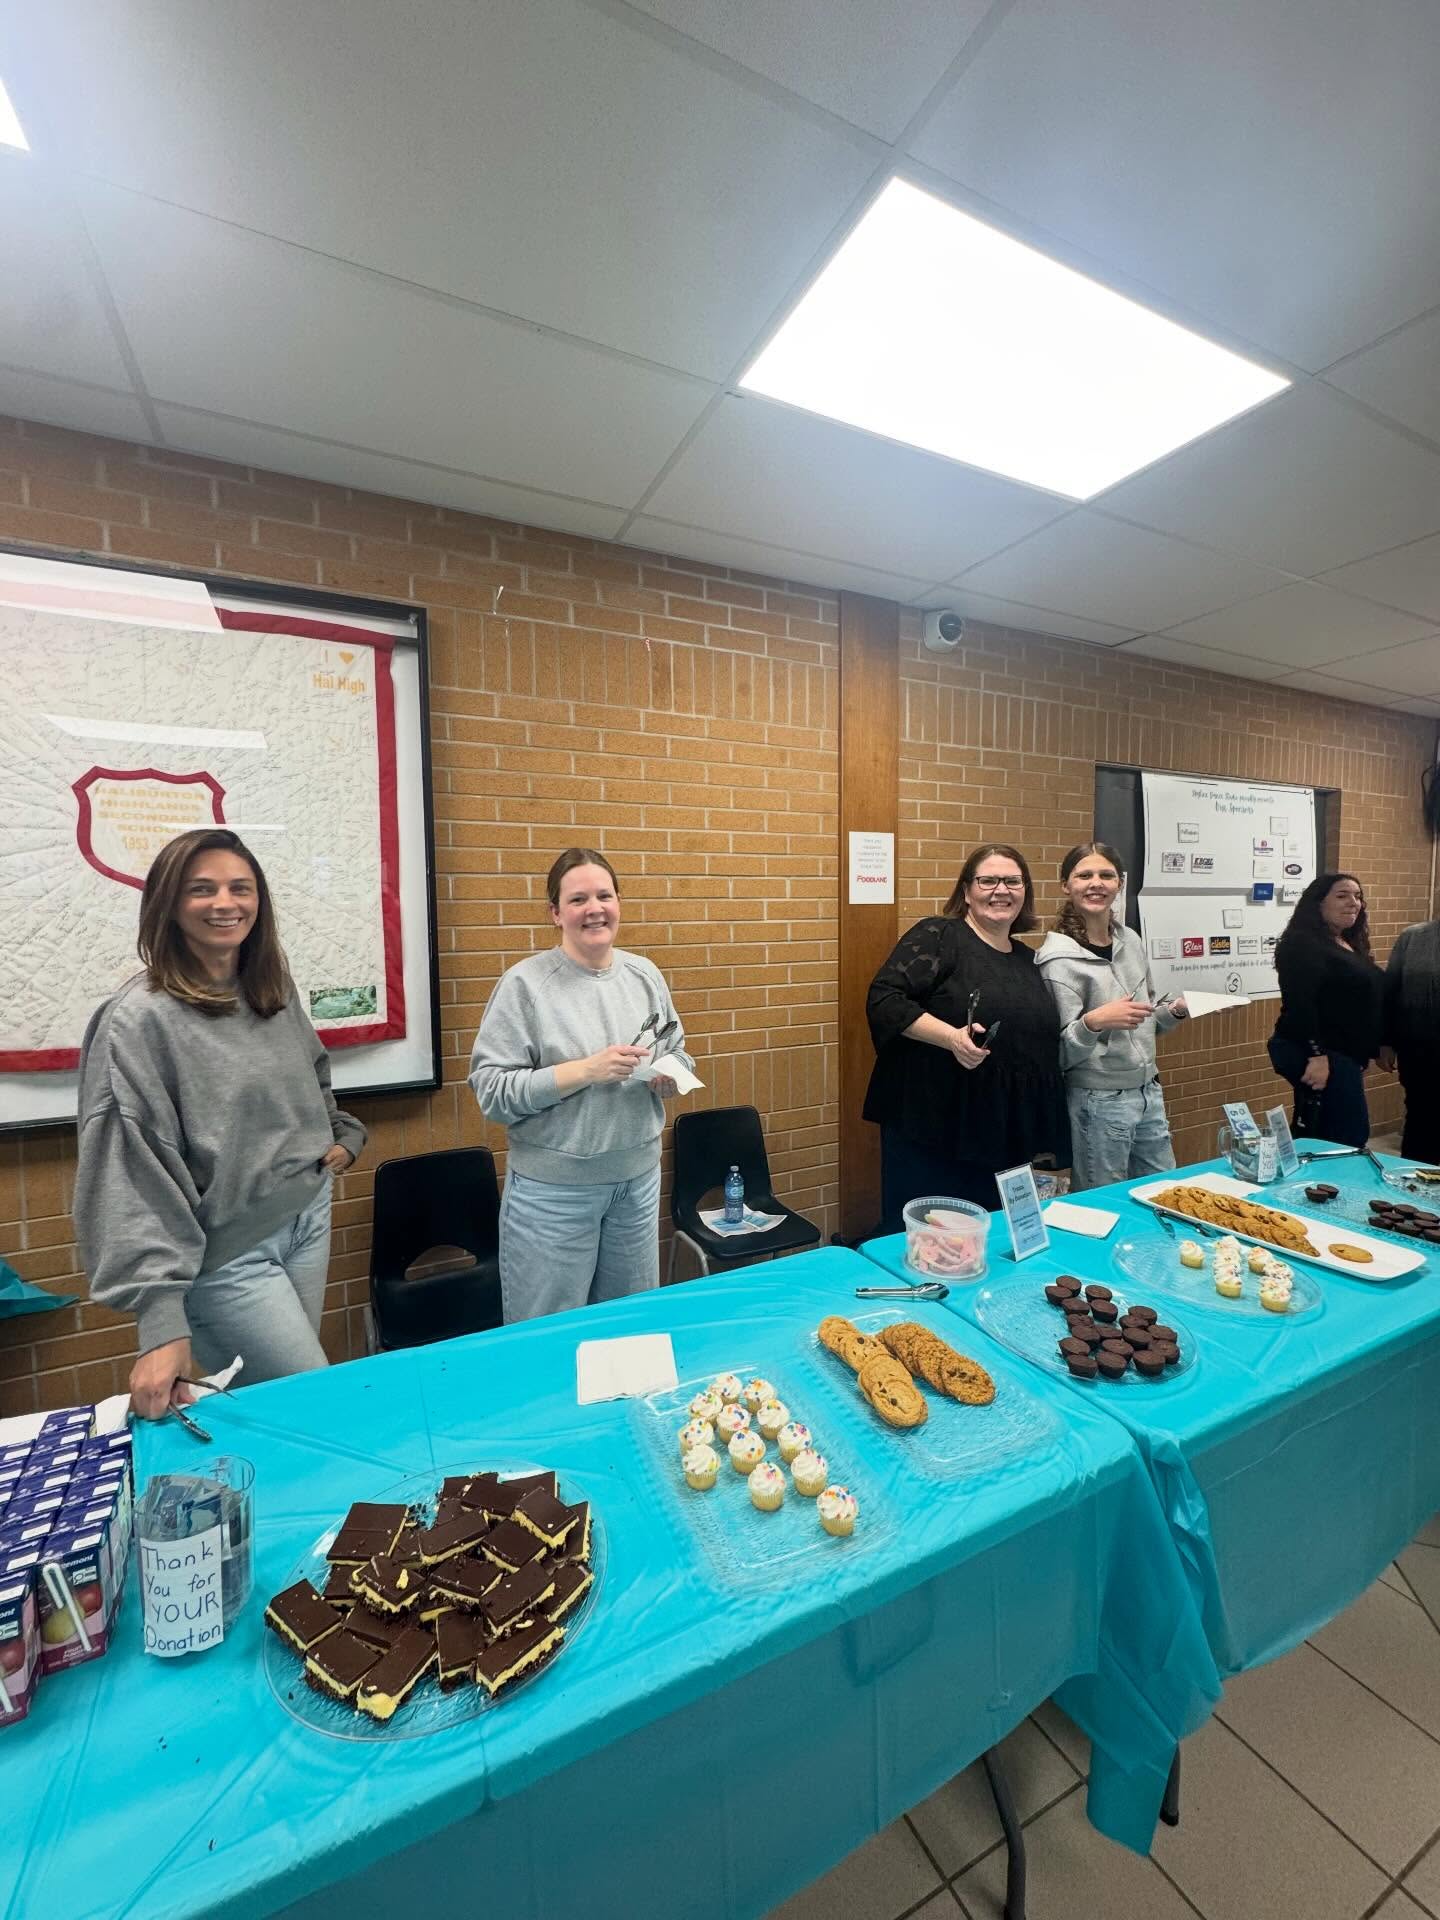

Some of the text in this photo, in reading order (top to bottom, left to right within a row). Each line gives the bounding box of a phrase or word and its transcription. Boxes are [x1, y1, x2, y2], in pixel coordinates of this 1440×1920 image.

[313, 673, 365, 695] Hal High
[100, 799, 201, 811] HIGHLANDS
[97, 810, 202, 823] SECONDARY
[857, 875, 888, 884] FOODLAND
[142, 1541, 214, 1571] Thank
[187, 1572, 216, 1593] for
[152, 1591, 220, 1623] YOUR
[145, 1624, 221, 1651] Donation
